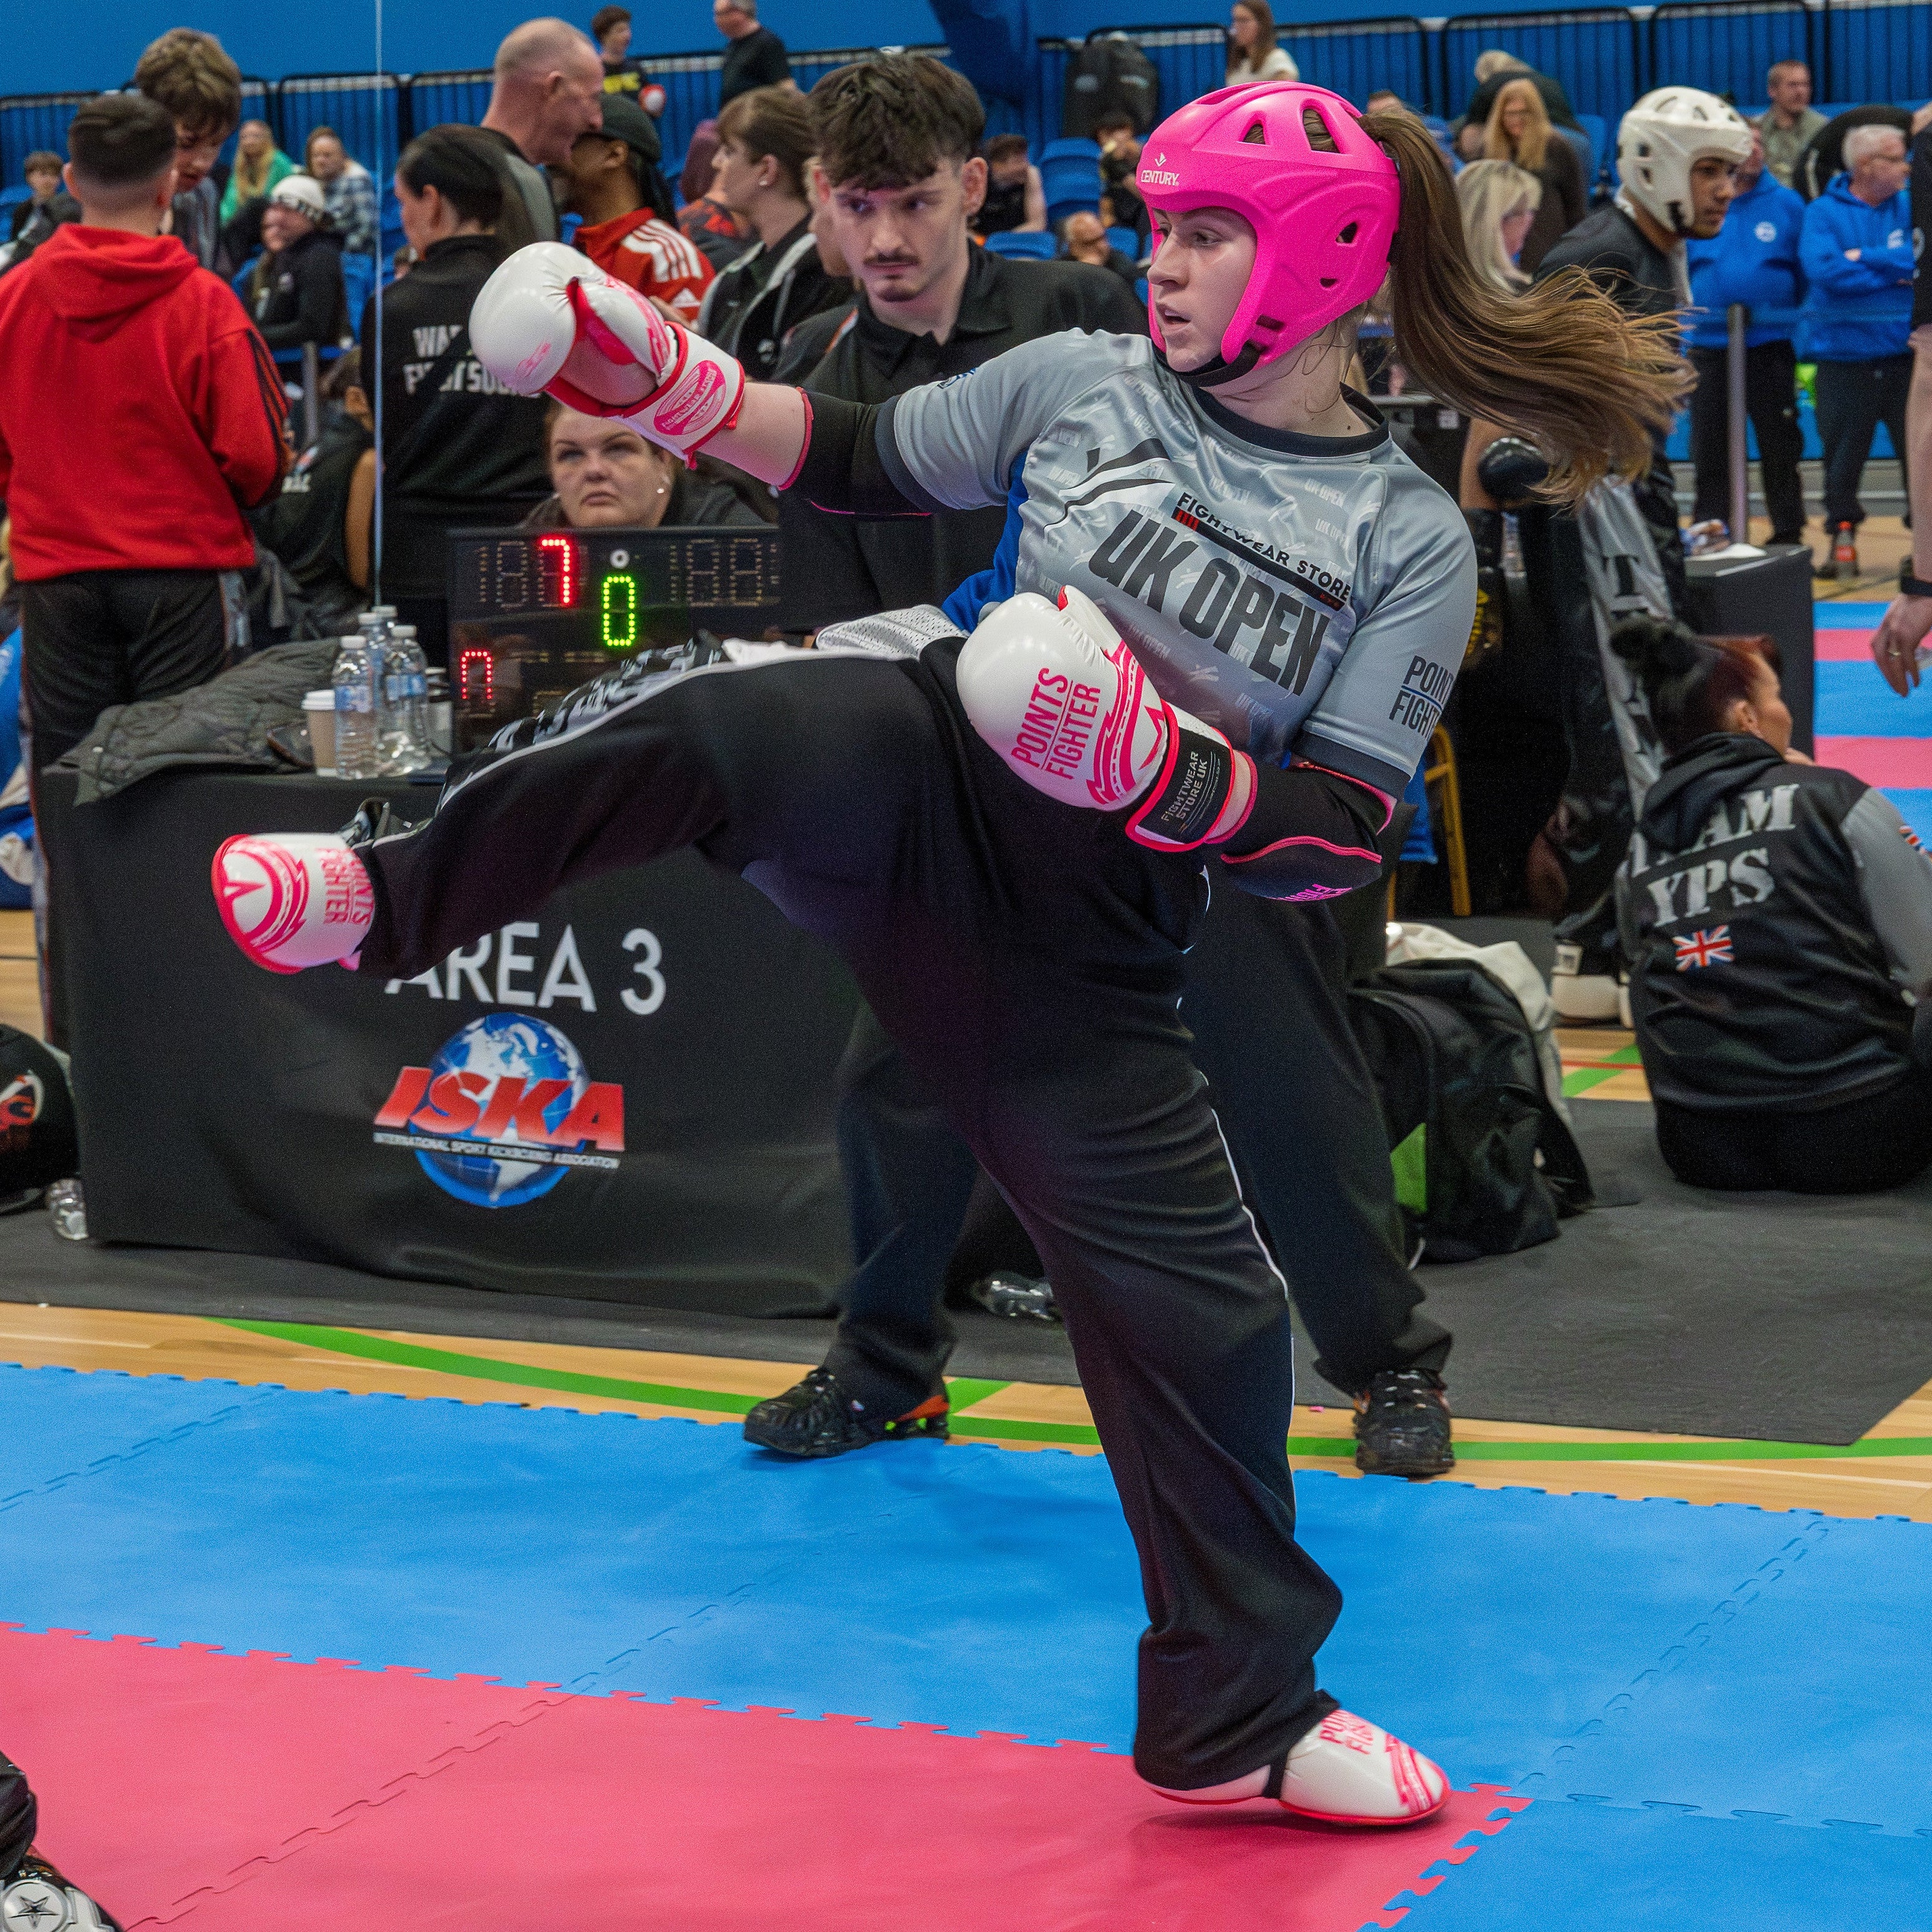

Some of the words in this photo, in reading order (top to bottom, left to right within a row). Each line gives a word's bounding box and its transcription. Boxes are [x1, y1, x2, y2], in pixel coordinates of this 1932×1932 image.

[1141, 170, 1180, 186] CENTURY
[538, 538, 571, 604] 7
[1177, 492, 1291, 567] FIGHTWEAR
[1296, 560, 1351, 601] STORE
[602, 575, 636, 647] 0
[1089, 508, 1199, 614] UK
[1178, 558, 1331, 697] OPEN
[1011, 667, 1069, 769] POINTS
[1045, 683, 1101, 780] FIGHTER
[1389, 689, 1440, 742] FIGHT
[1161, 750, 1198, 822] FIGHTWEAR
[1176, 780, 1203, 820] STORE
[1197, 759, 1208, 779] UK
[1647, 847, 1775, 928] YPS
[620, 928, 666, 1014] 3
[374, 1066, 625, 1152] ISKA
